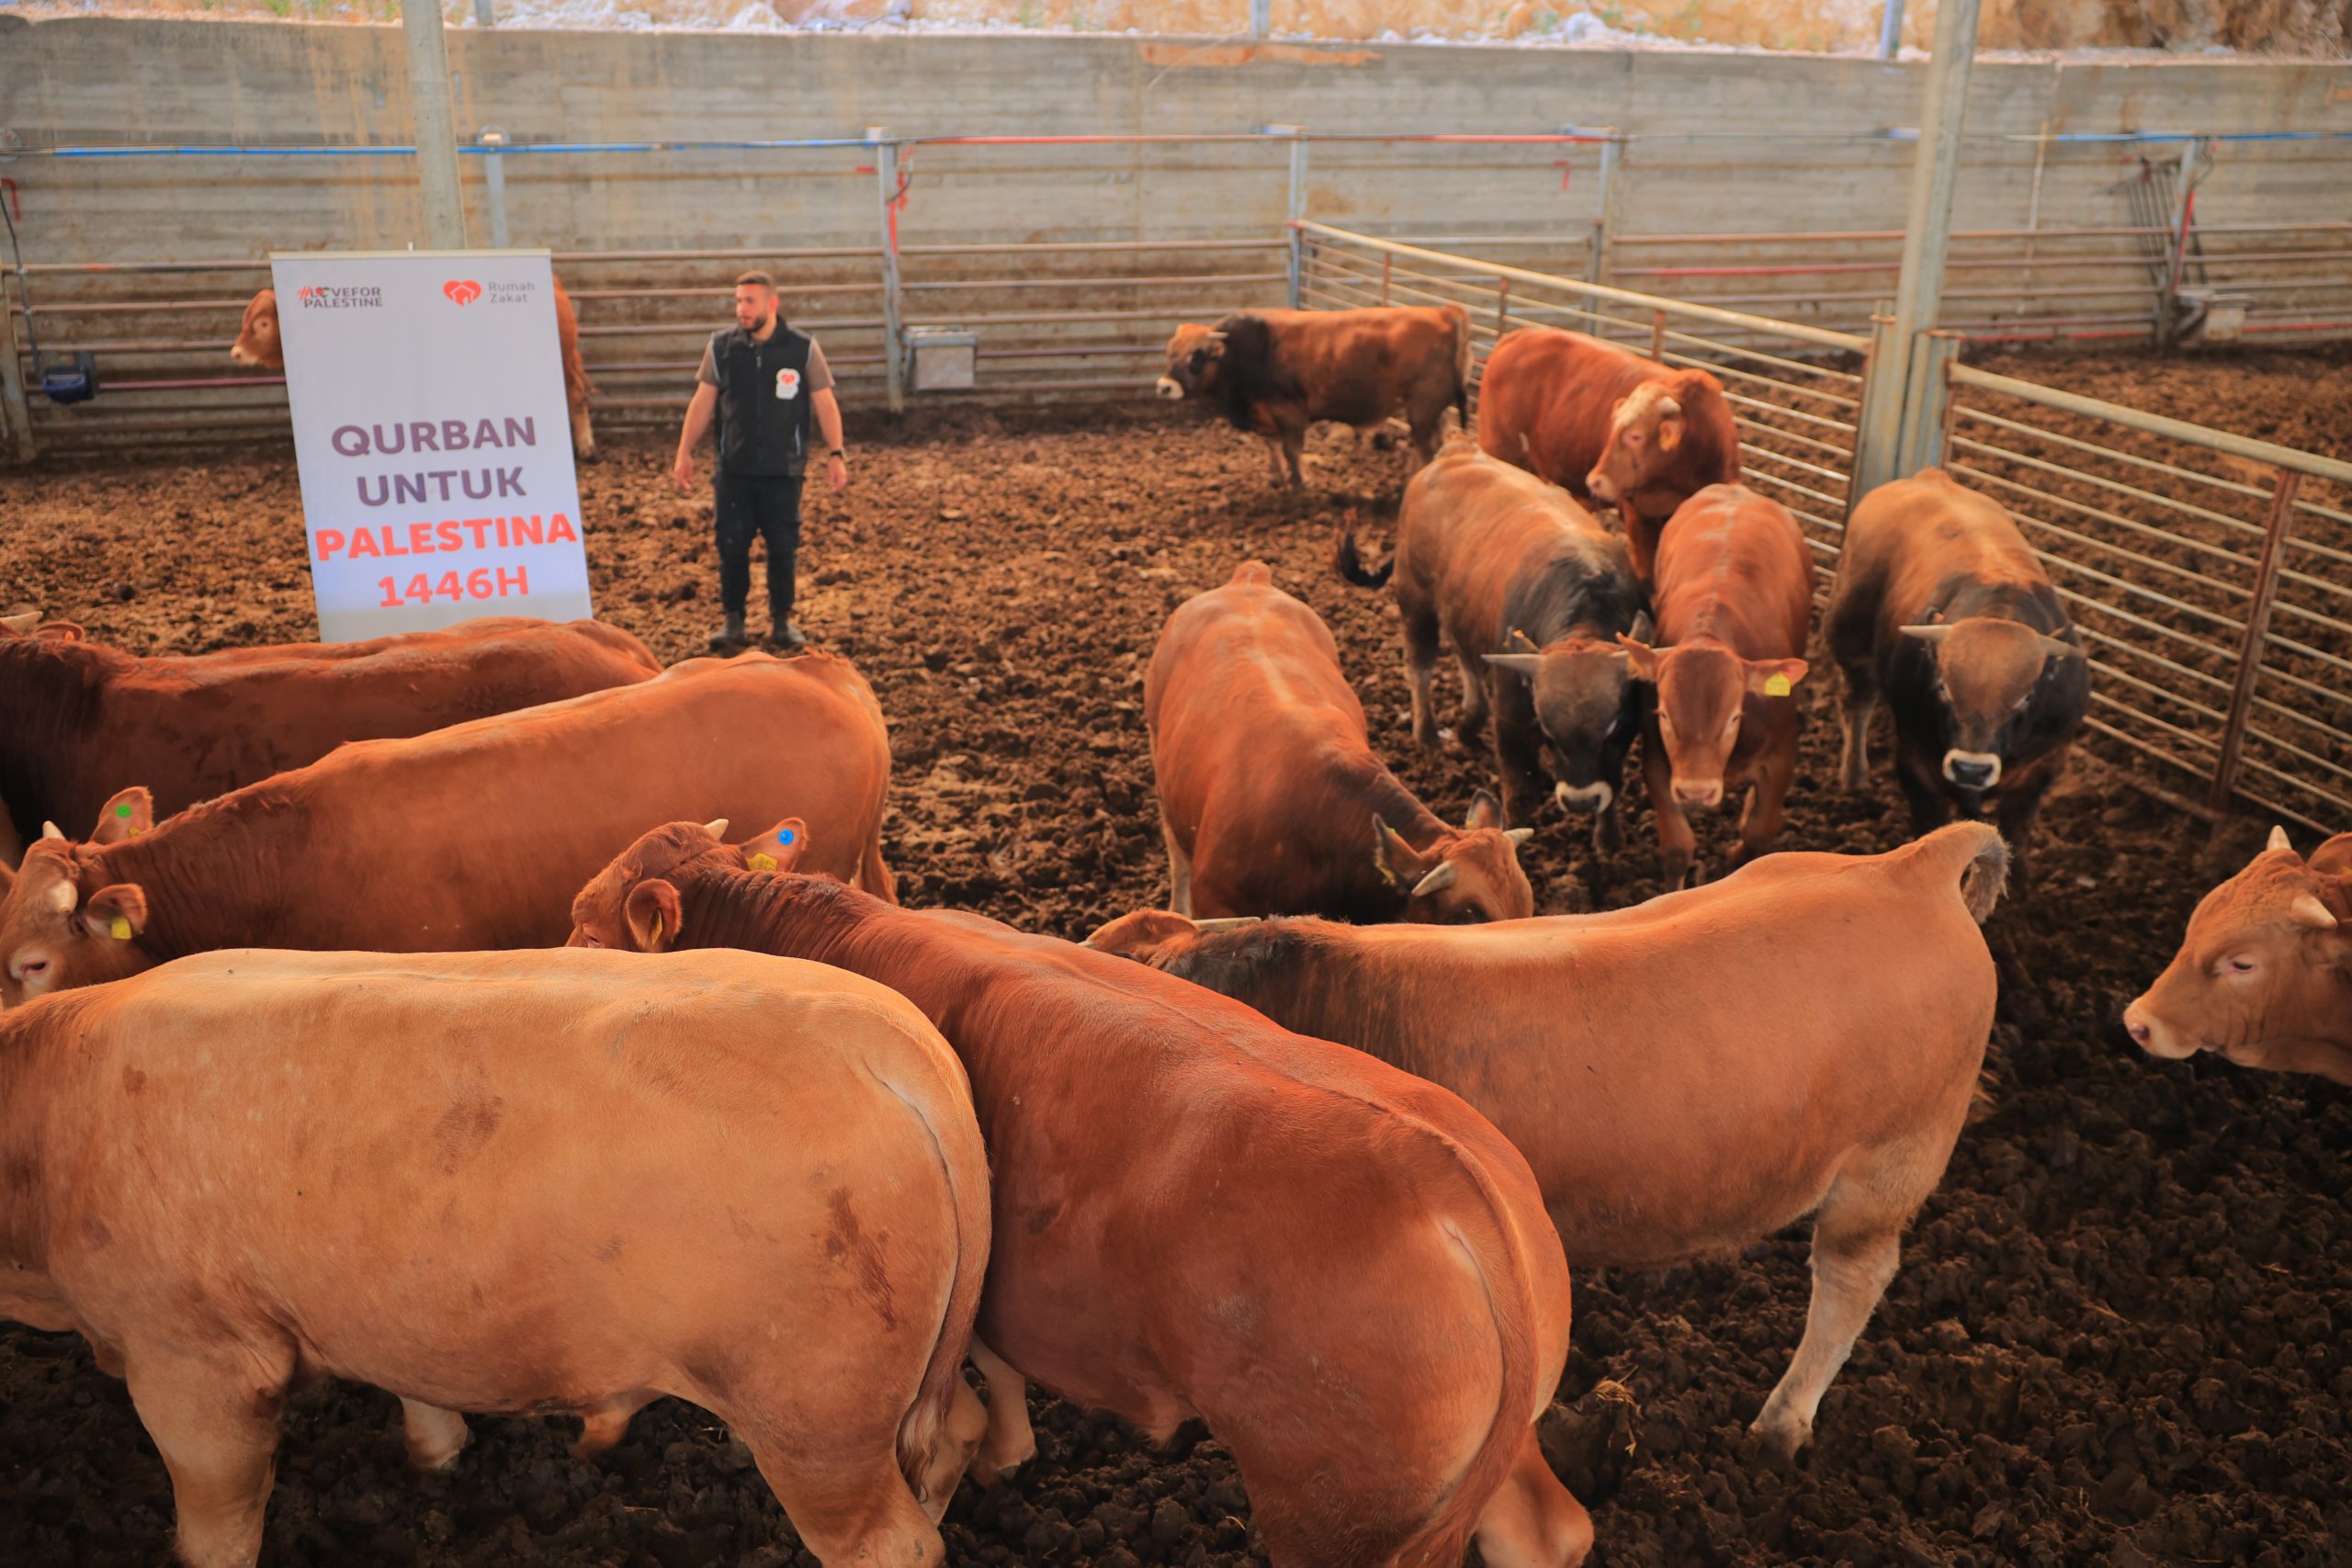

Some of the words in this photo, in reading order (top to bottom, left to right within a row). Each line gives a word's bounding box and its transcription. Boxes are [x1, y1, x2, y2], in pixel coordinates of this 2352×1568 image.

[304, 297, 383, 309] PALESTINE
[488, 281, 536, 292] Rumah
[490, 293, 529, 303] Zakat
[331, 416, 537, 457] QURBAN
[356, 466, 527, 507] UNTUK
[314, 513, 578, 562] PALESTINA
[378, 565, 529, 608] 1446H
